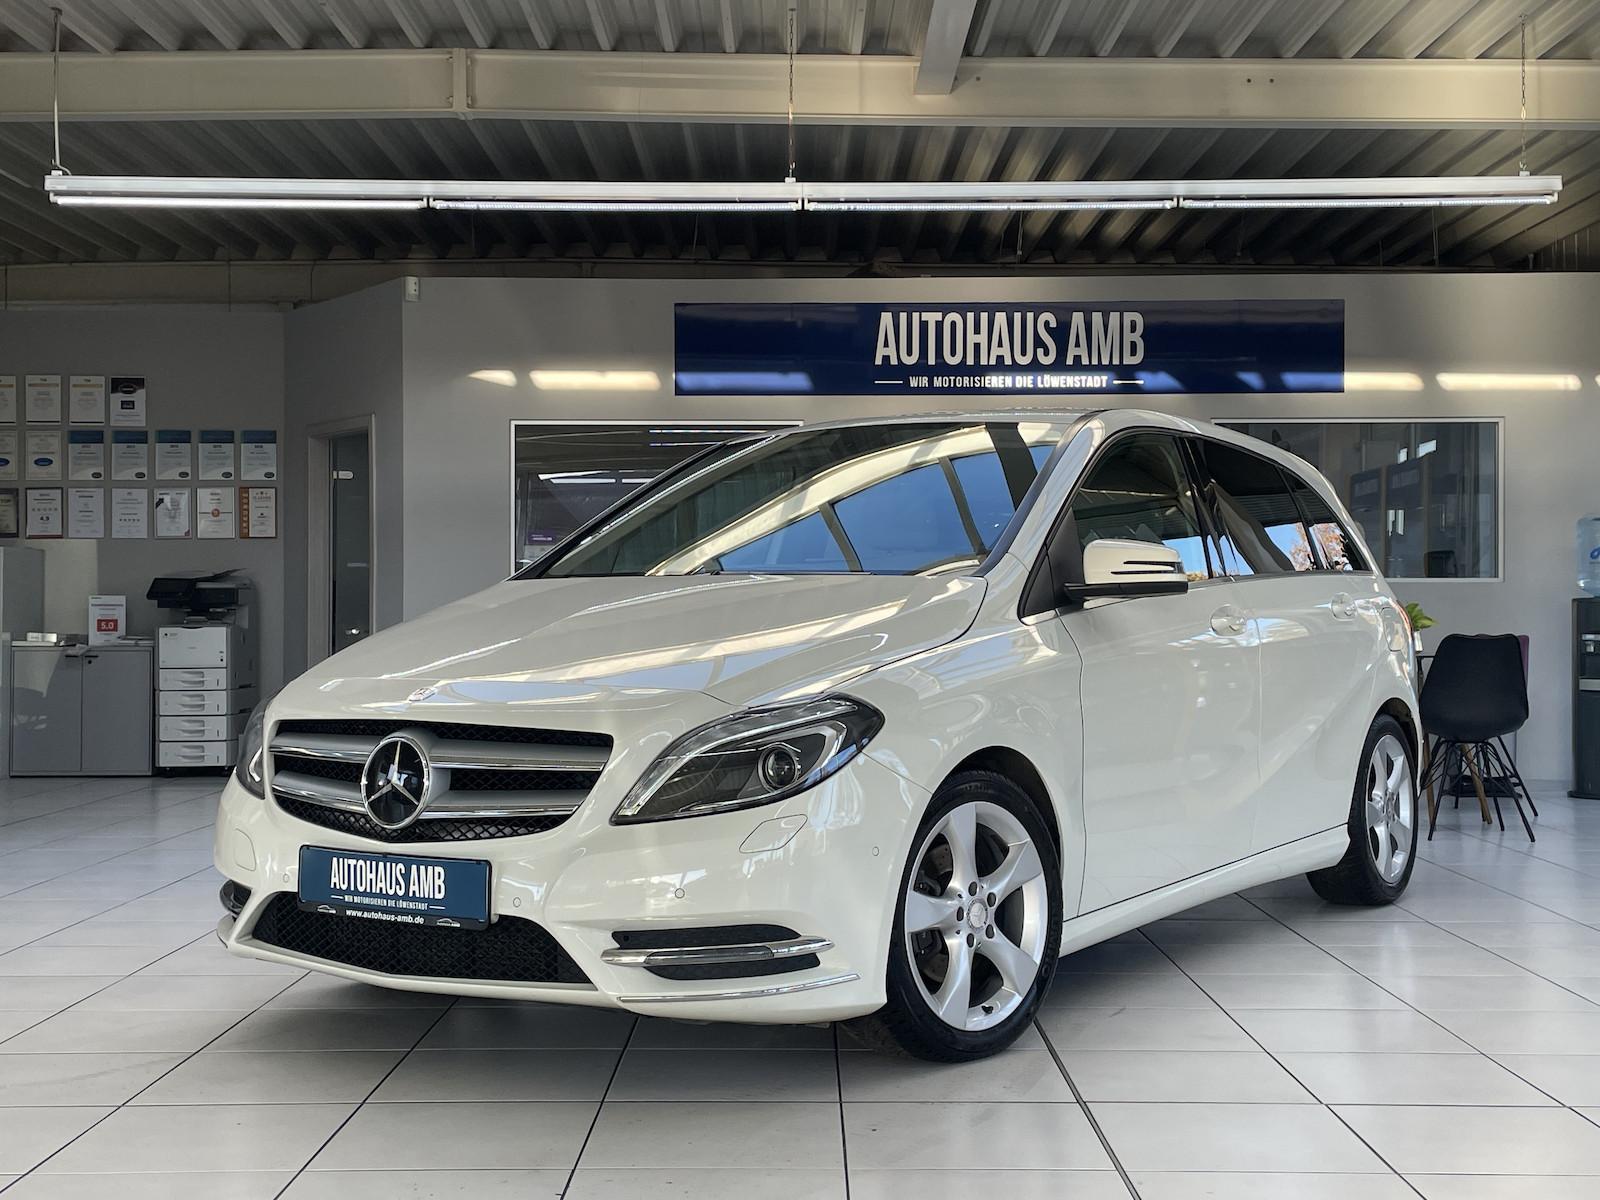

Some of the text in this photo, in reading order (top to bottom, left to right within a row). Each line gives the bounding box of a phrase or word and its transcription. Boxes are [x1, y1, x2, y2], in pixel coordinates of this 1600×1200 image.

[874, 311, 1145, 366] AUTOHAUS AMB
[909, 374, 1108, 388] WIR MOTORISIEREN DIE LÖWENSTADT
[101, 621, 114, 630] 5.0
[330, 857, 446, 900] AUTOHAUS AMB
[345, 909, 425, 925] www.autohaus-amb.de
